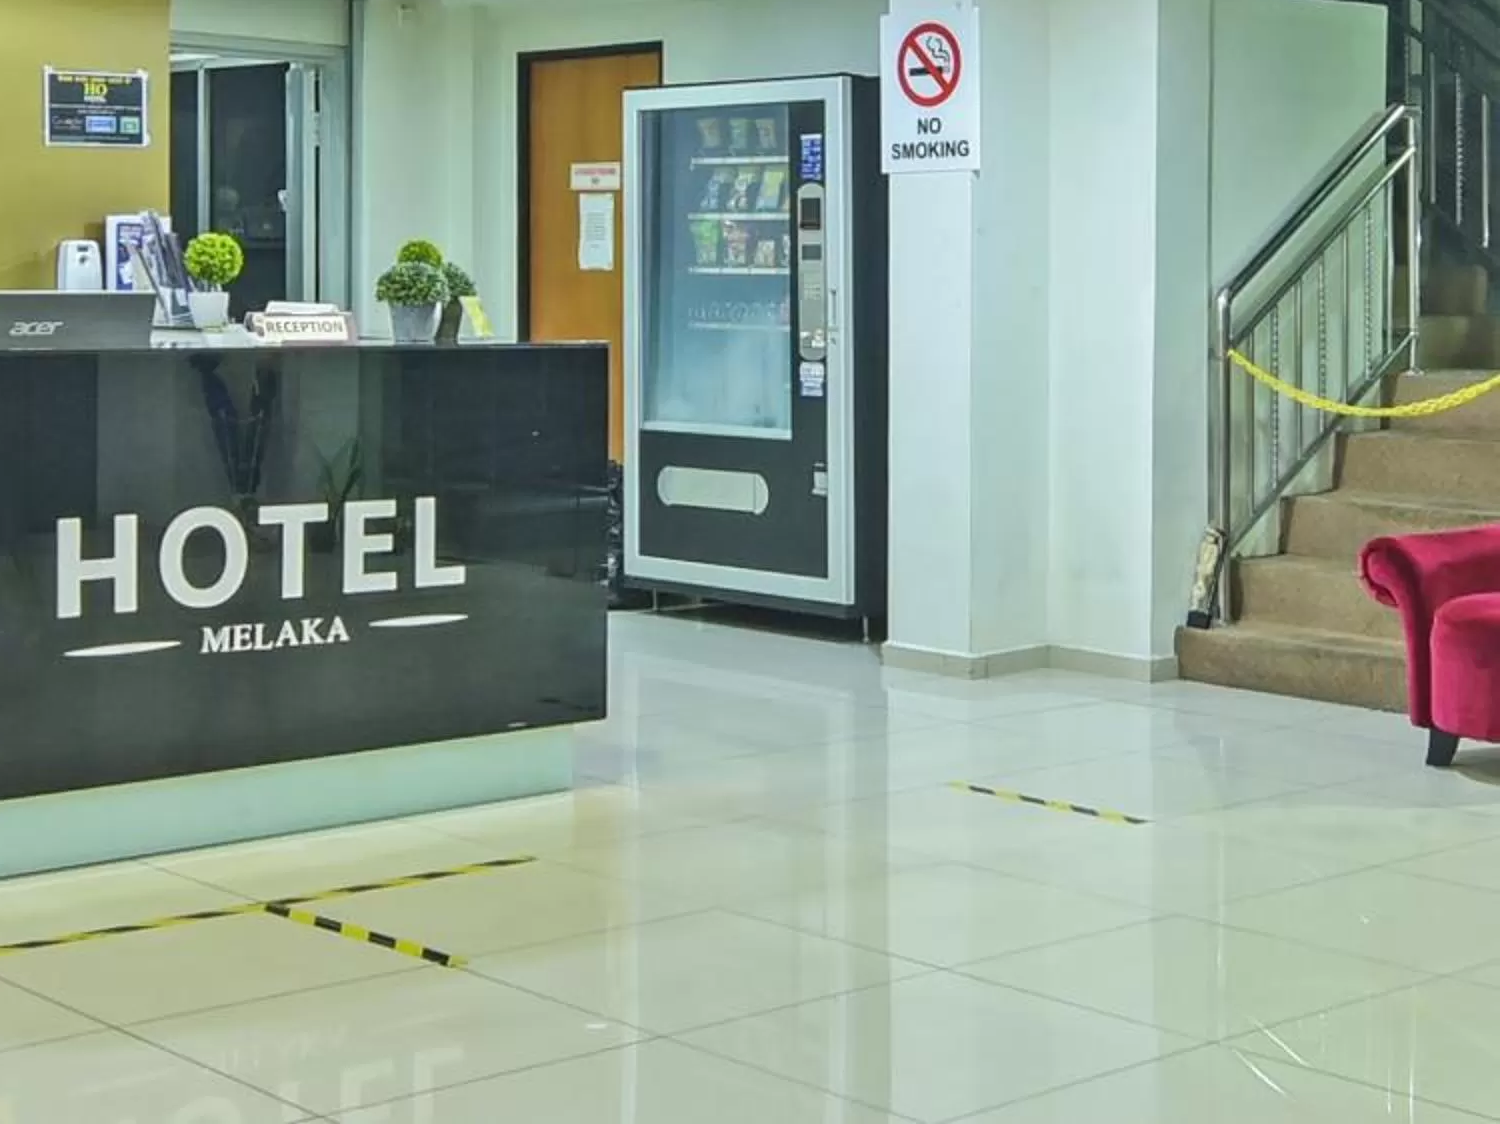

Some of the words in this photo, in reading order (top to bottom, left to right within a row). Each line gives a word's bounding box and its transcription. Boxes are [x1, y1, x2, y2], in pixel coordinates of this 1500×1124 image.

[917, 117, 942, 135] NO
[891, 139, 970, 160] SMOKING
[8, 321, 64, 336] acer
[265, 320, 343, 333] RECEPTION
[56, 496, 467, 619] HOTEL
[201, 616, 350, 654] MELAKA
